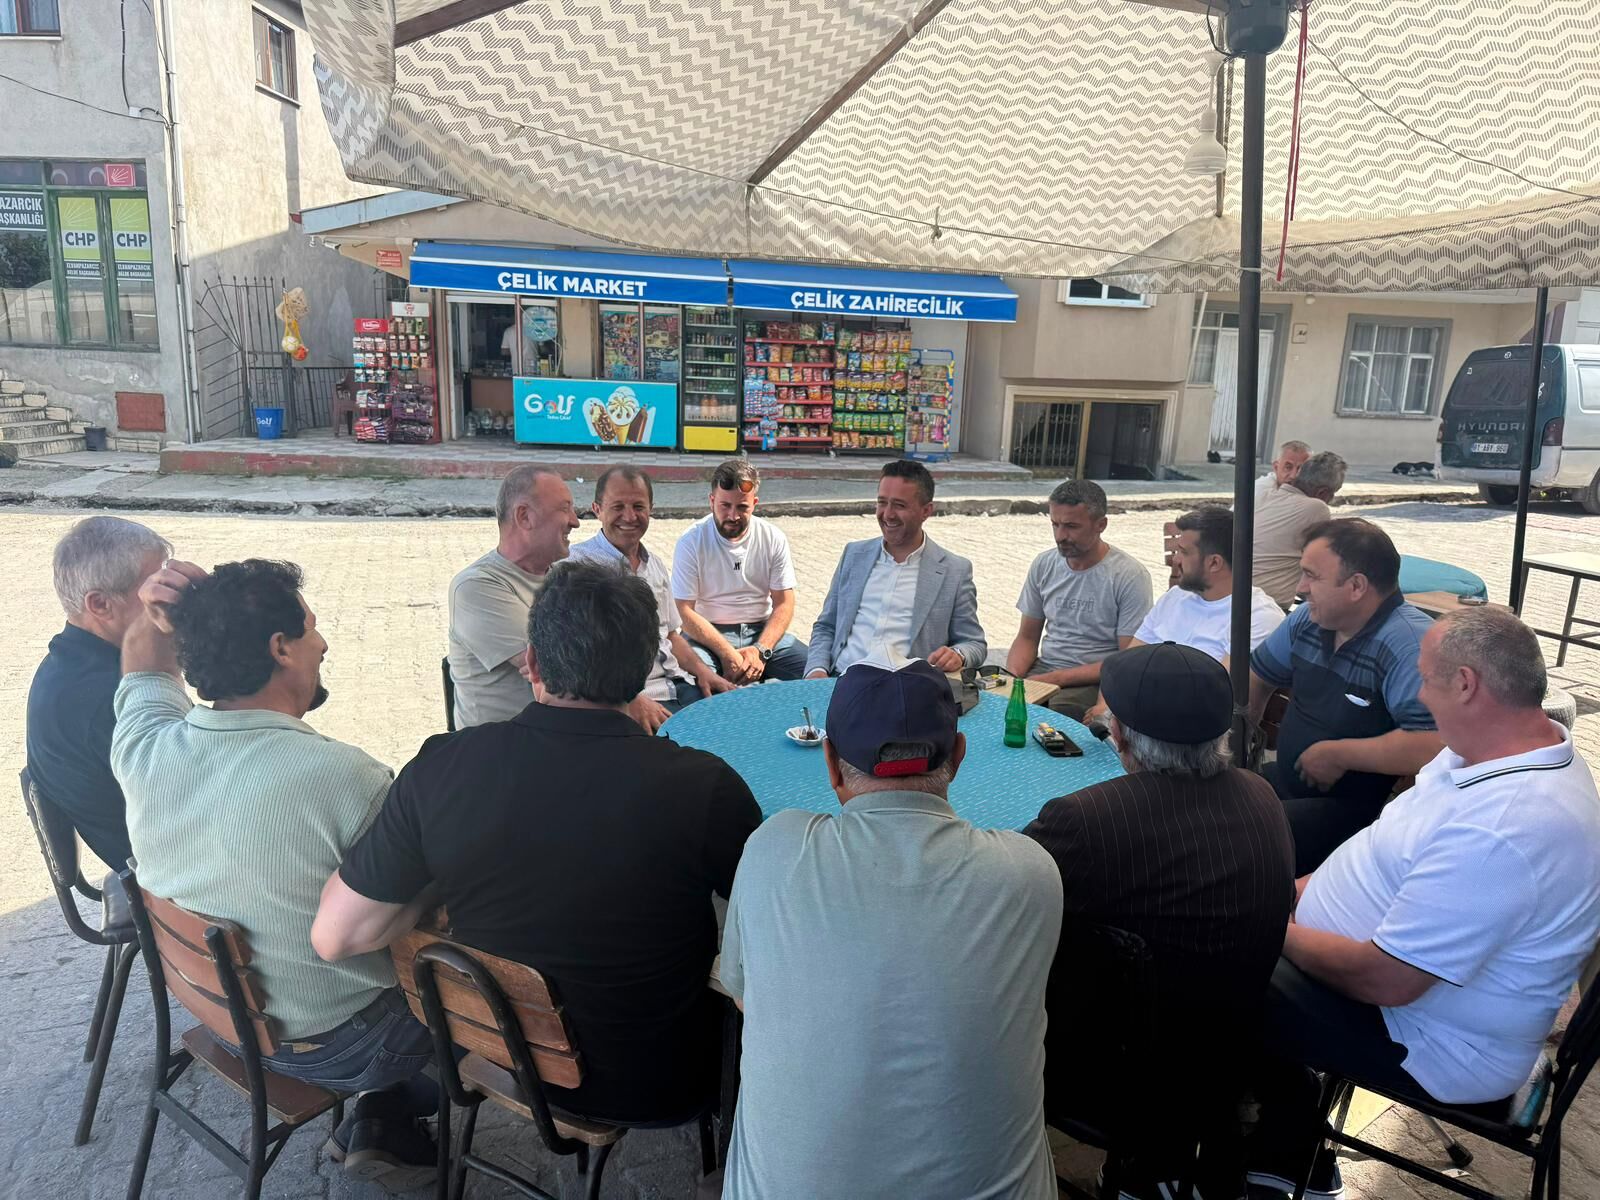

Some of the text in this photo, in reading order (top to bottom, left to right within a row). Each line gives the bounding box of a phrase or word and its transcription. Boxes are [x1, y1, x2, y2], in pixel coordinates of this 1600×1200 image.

[65, 232, 96, 246] CHP
[116, 233, 148, 247] CHP
[497, 271, 648, 297] ÇELİK MARKET
[790, 290, 964, 316] ÇELİK ZAHİRECİLİK
[524, 393, 576, 415] Golf
[1457, 422, 1527, 431] HYUNDAI
